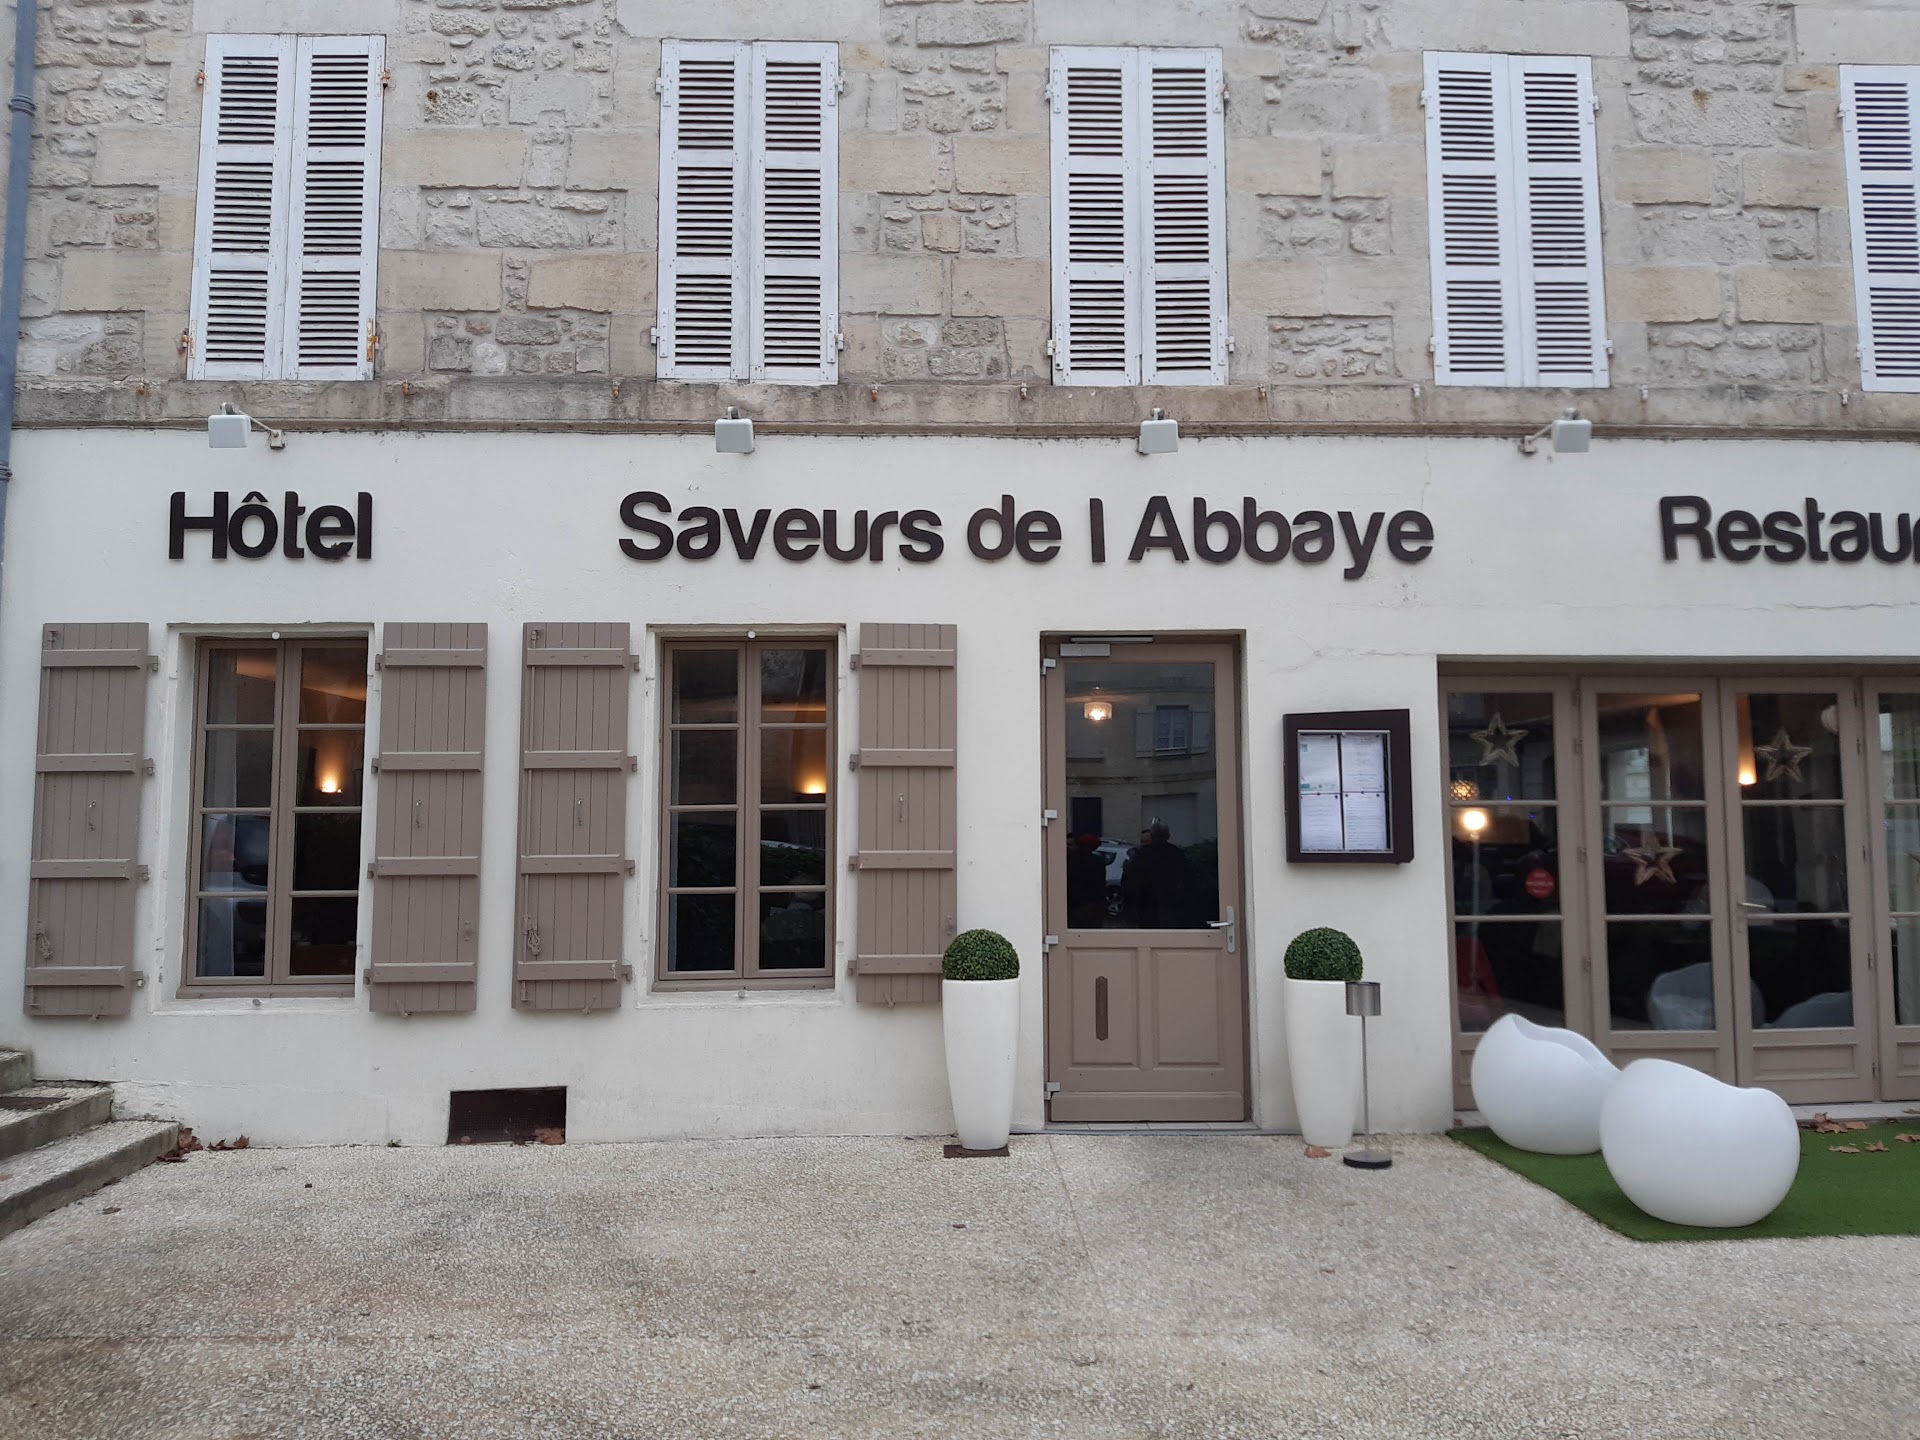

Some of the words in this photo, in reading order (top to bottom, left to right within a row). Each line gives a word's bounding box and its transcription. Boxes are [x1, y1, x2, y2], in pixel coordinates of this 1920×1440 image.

[169, 491, 373, 561] Hôtel
[619, 491, 944, 564] Saveurs
[967, 495, 1061, 564] de
[1128, 495, 1434, 580] Abbaye
[1659, 496, 1920, 564] Restau
